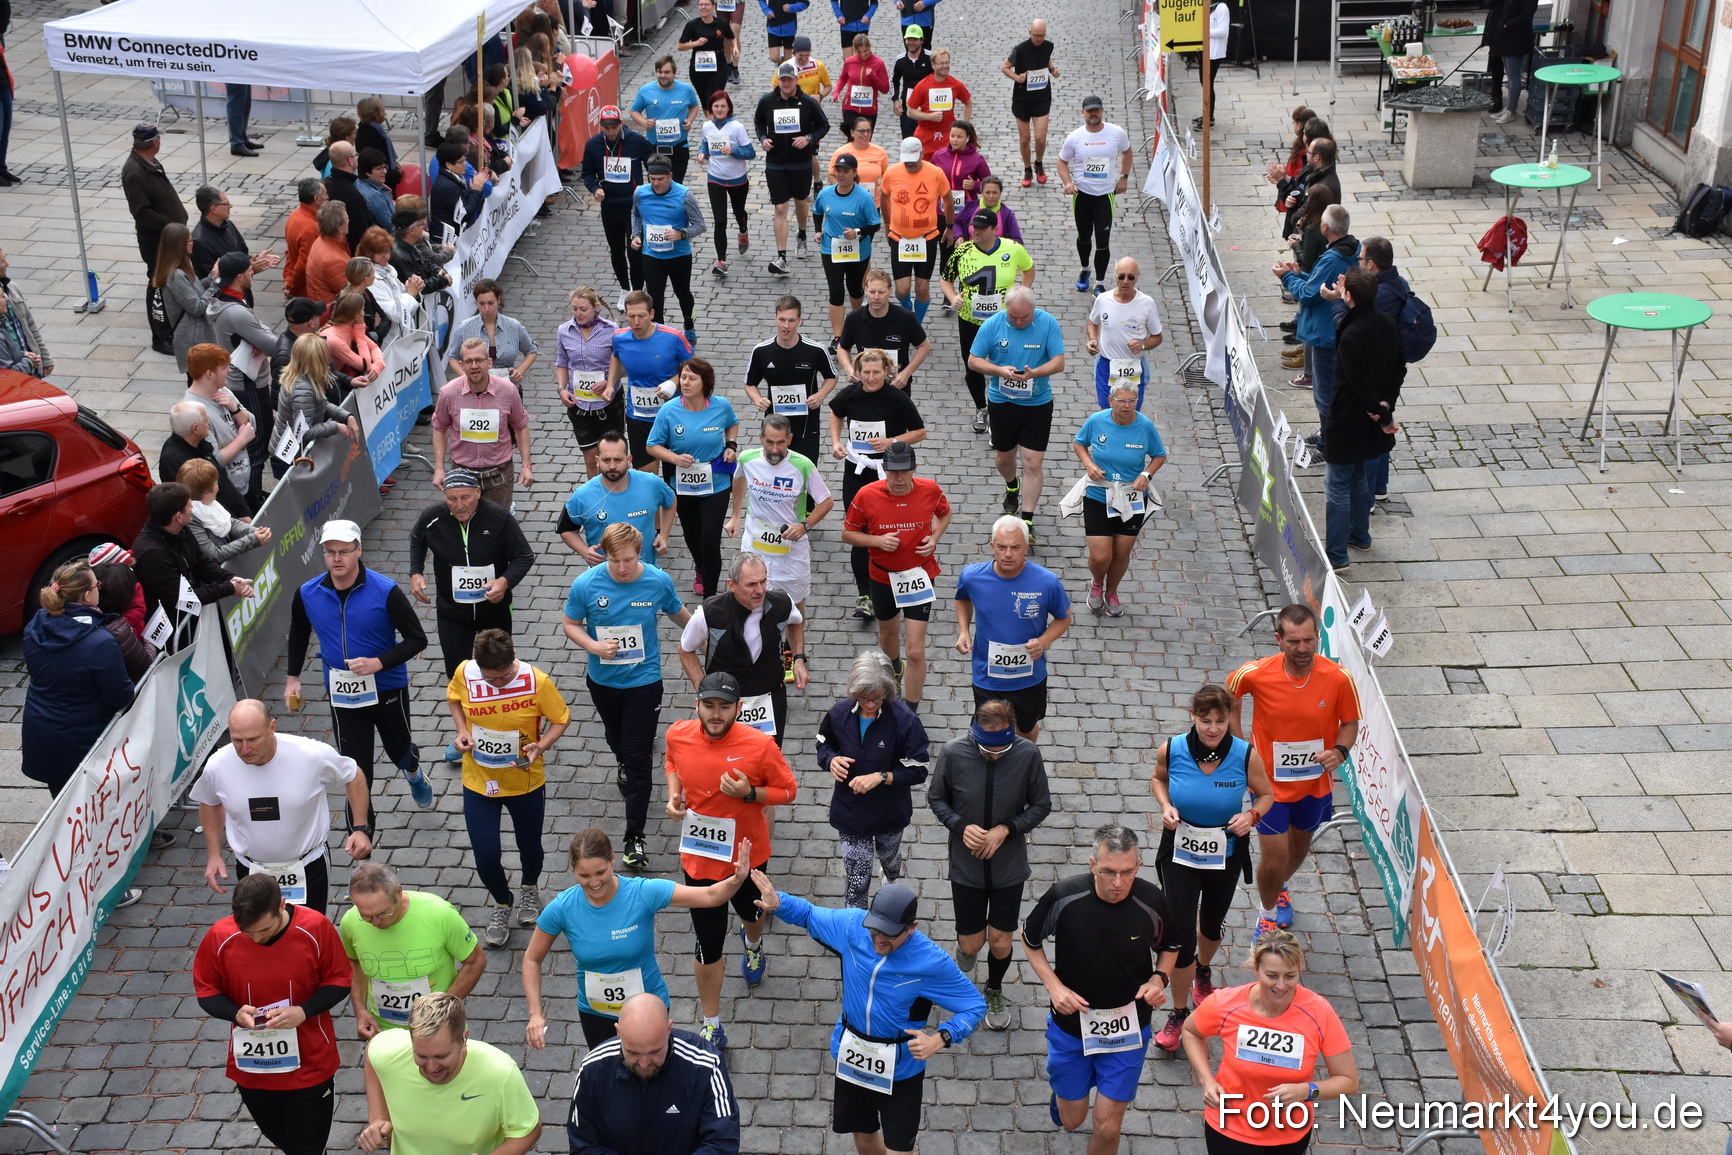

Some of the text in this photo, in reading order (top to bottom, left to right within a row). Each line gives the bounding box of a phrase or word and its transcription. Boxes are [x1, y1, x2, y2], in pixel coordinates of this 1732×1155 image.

[1174, 10, 1196, 22] lauf
[64, 33, 258, 61] BMW ConnectedDrive
[67, 52, 216, 72] Vernetzt, um frei zu sein.
[1030, 74, 1046, 84] 2775
[854, 91, 870, 100] 2732
[934, 94, 948, 103] 407
[778, 116, 796, 124] 2658
[660, 126, 676, 134] 2521
[710, 142, 726, 150] 2657
[608, 164, 627, 174] 2404
[1086, 164, 1106, 173] 2267
[650, 234, 668, 242] 2654
[838, 244, 852, 252] 148
[904, 244, 920, 252] 241
[976, 303, 998, 312] 2665
[1118, 368, 1134, 377] 192
[1004, 379, 1028, 390] 2546
[636, 396, 660, 406] 2114
[777, 394, 800, 404] 2261
[469, 419, 490, 431] 292
[854, 431, 880, 440] 2744
[282, 438, 295, 458] swn
[681, 473, 707, 482] 2302
[752, 478, 772, 488] TEAM
[758, 496, 782, 504] FEUCHT
[761, 532, 782, 544] 404
[458, 578, 488, 590] 2591
[896, 578, 925, 594] 2745
[228, 556, 278, 649] BOCK
[151, 621, 165, 642] swn
[1372, 628, 1388, 650] swn
[994, 654, 1027, 666] 2042
[335, 680, 367, 694] 2021
[468, 698, 536, 716] MAX BÖGL
[736, 707, 767, 722] 2592
[478, 738, 512, 754] 2623
[1281, 752, 1317, 766] 2574
[689, 824, 728, 842] 2418
[694, 841, 720, 852] Johannes
[1181, 836, 1218, 854] 2649
[604, 987, 626, 1002] 93
[1461, 998, 1470, 1014] für
[1467, 1012, 1476, 1028] die
[1472, 993, 1492, 1041] Neumarkts
[20, 985, 72, 1070] Service-Line:
[1090, 1016, 1130, 1036] 2390
[1246, 1030, 1294, 1053] 2423
[242, 1040, 288, 1056] 2410
[845, 1048, 886, 1074] 2219
[1261, 1056, 1276, 1064] Ines
